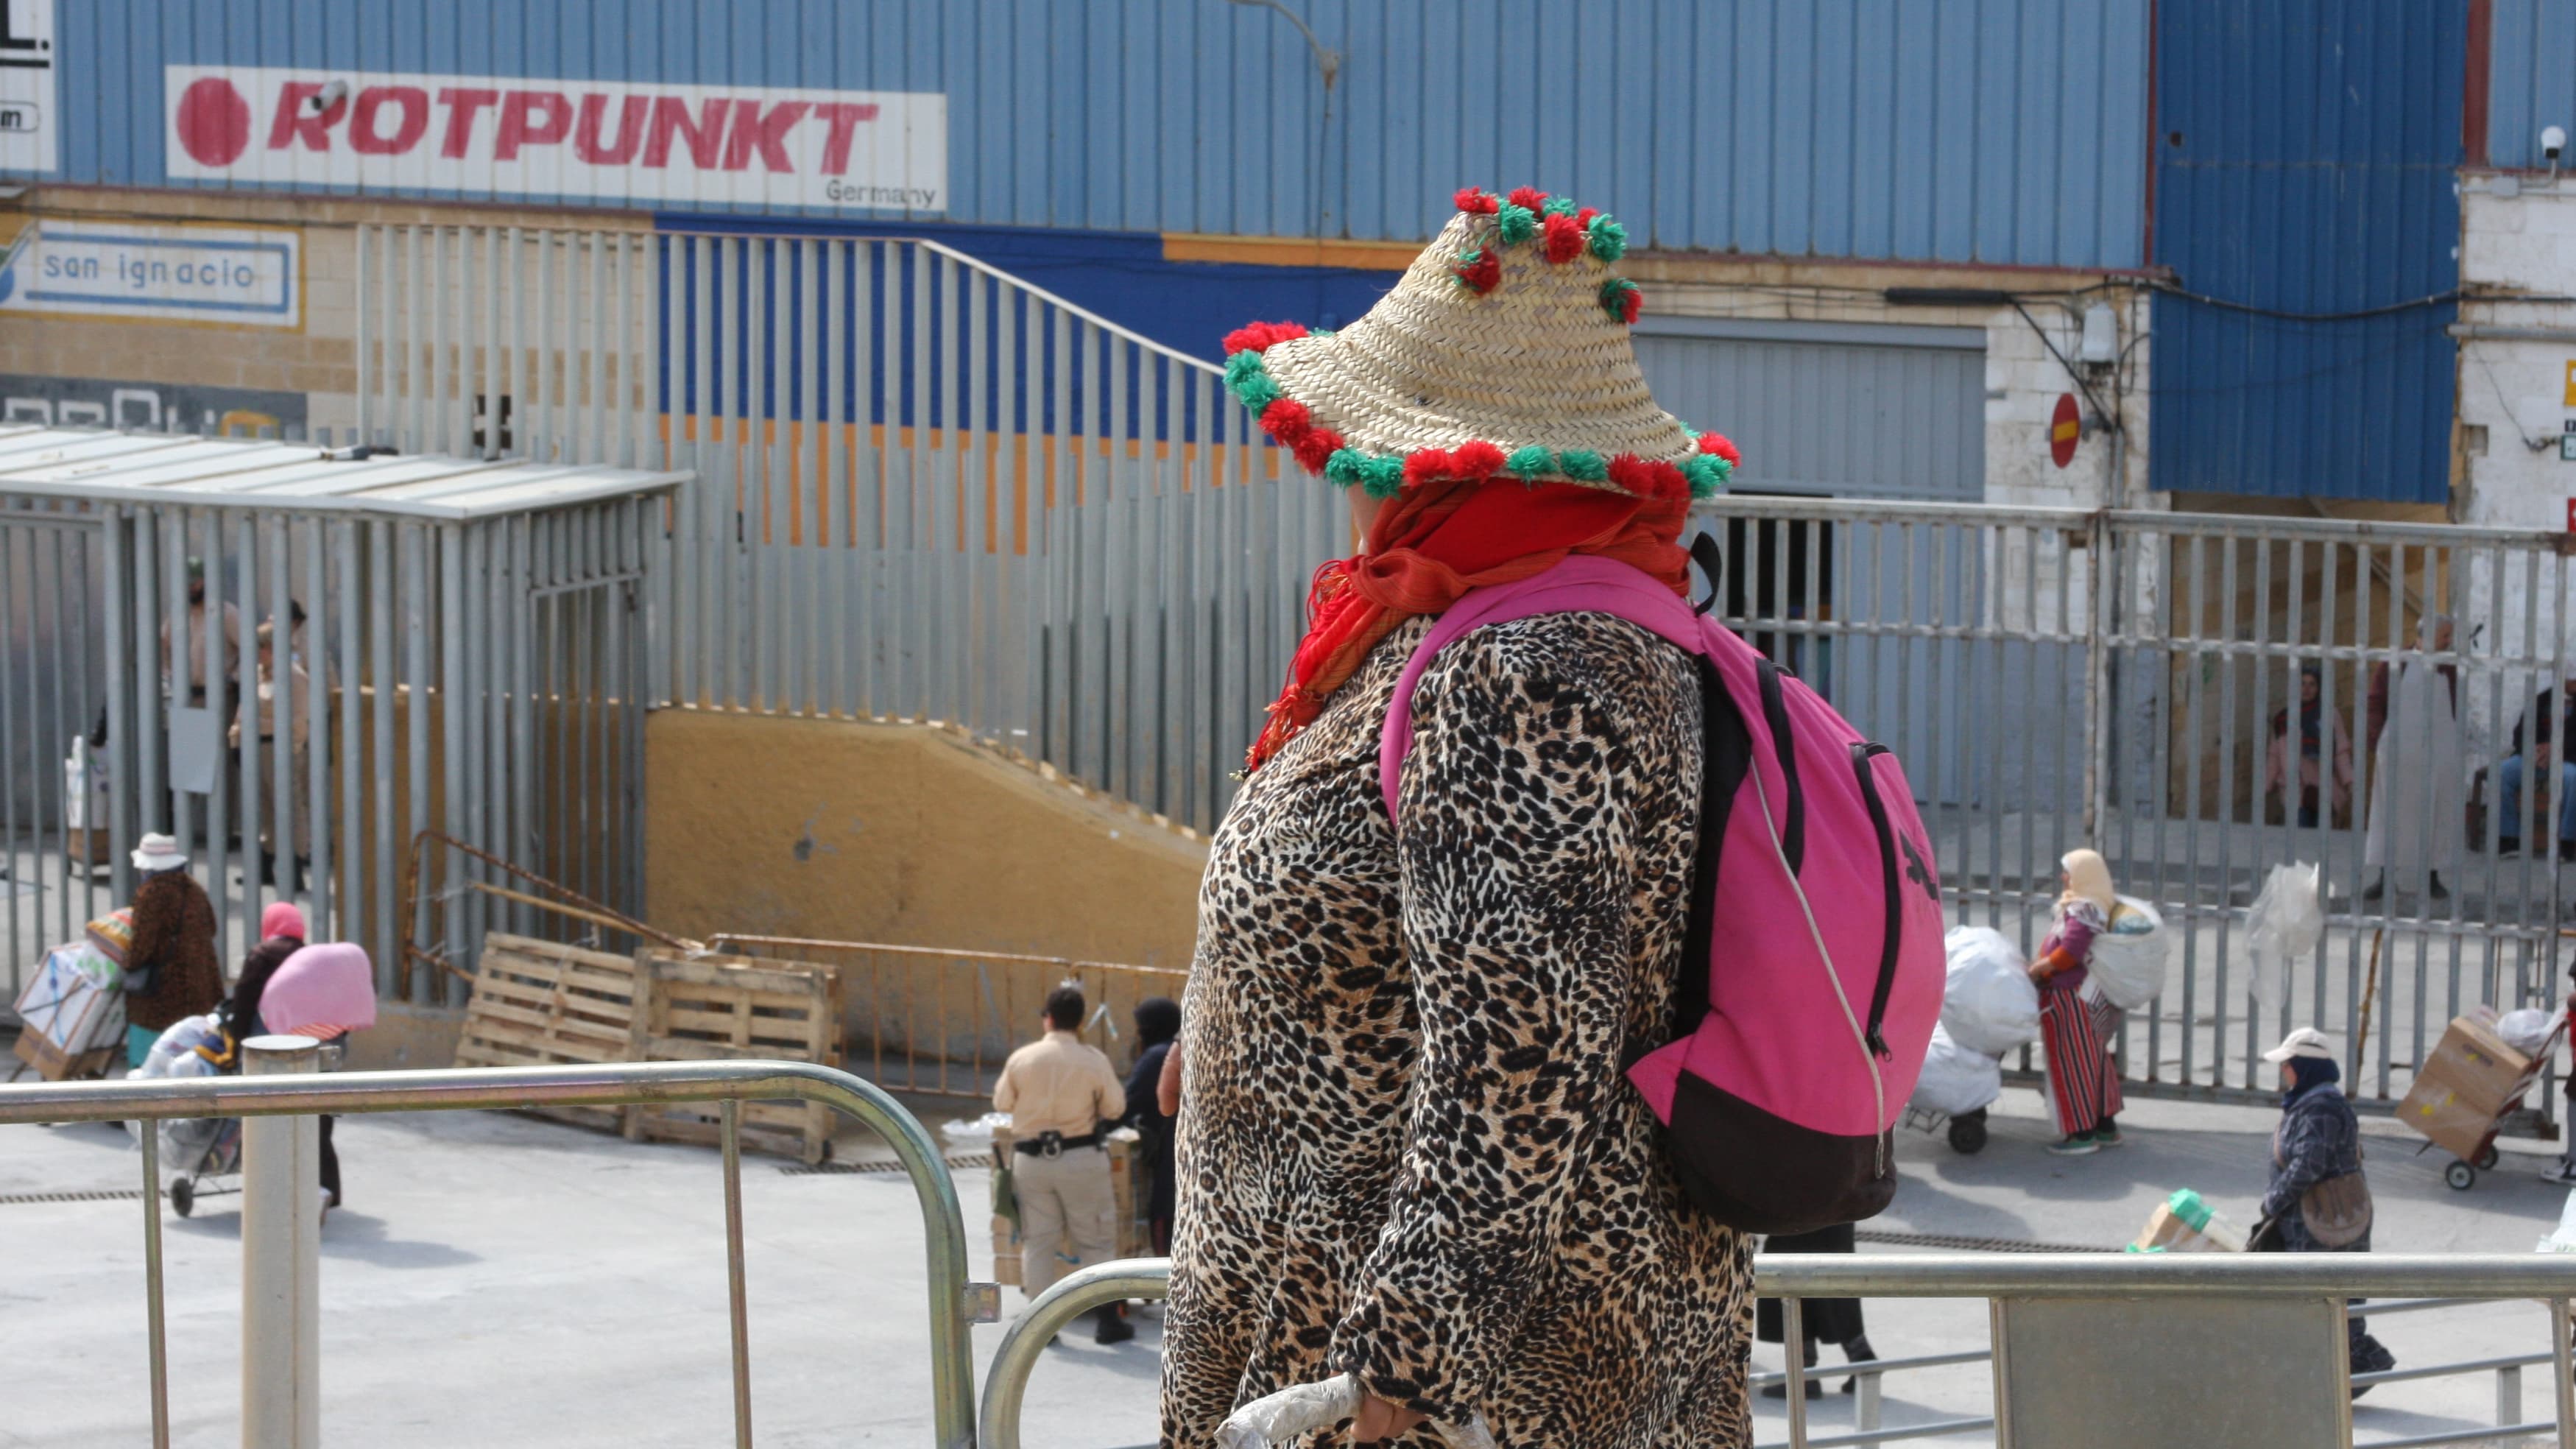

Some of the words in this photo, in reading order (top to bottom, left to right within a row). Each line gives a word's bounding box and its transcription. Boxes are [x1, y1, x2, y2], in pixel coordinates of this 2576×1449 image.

[267, 81, 880, 176] ROTPUNKT
[825, 179, 936, 208] Germany
[44, 255, 99, 279] san
[118, 253, 254, 289] ignacio
